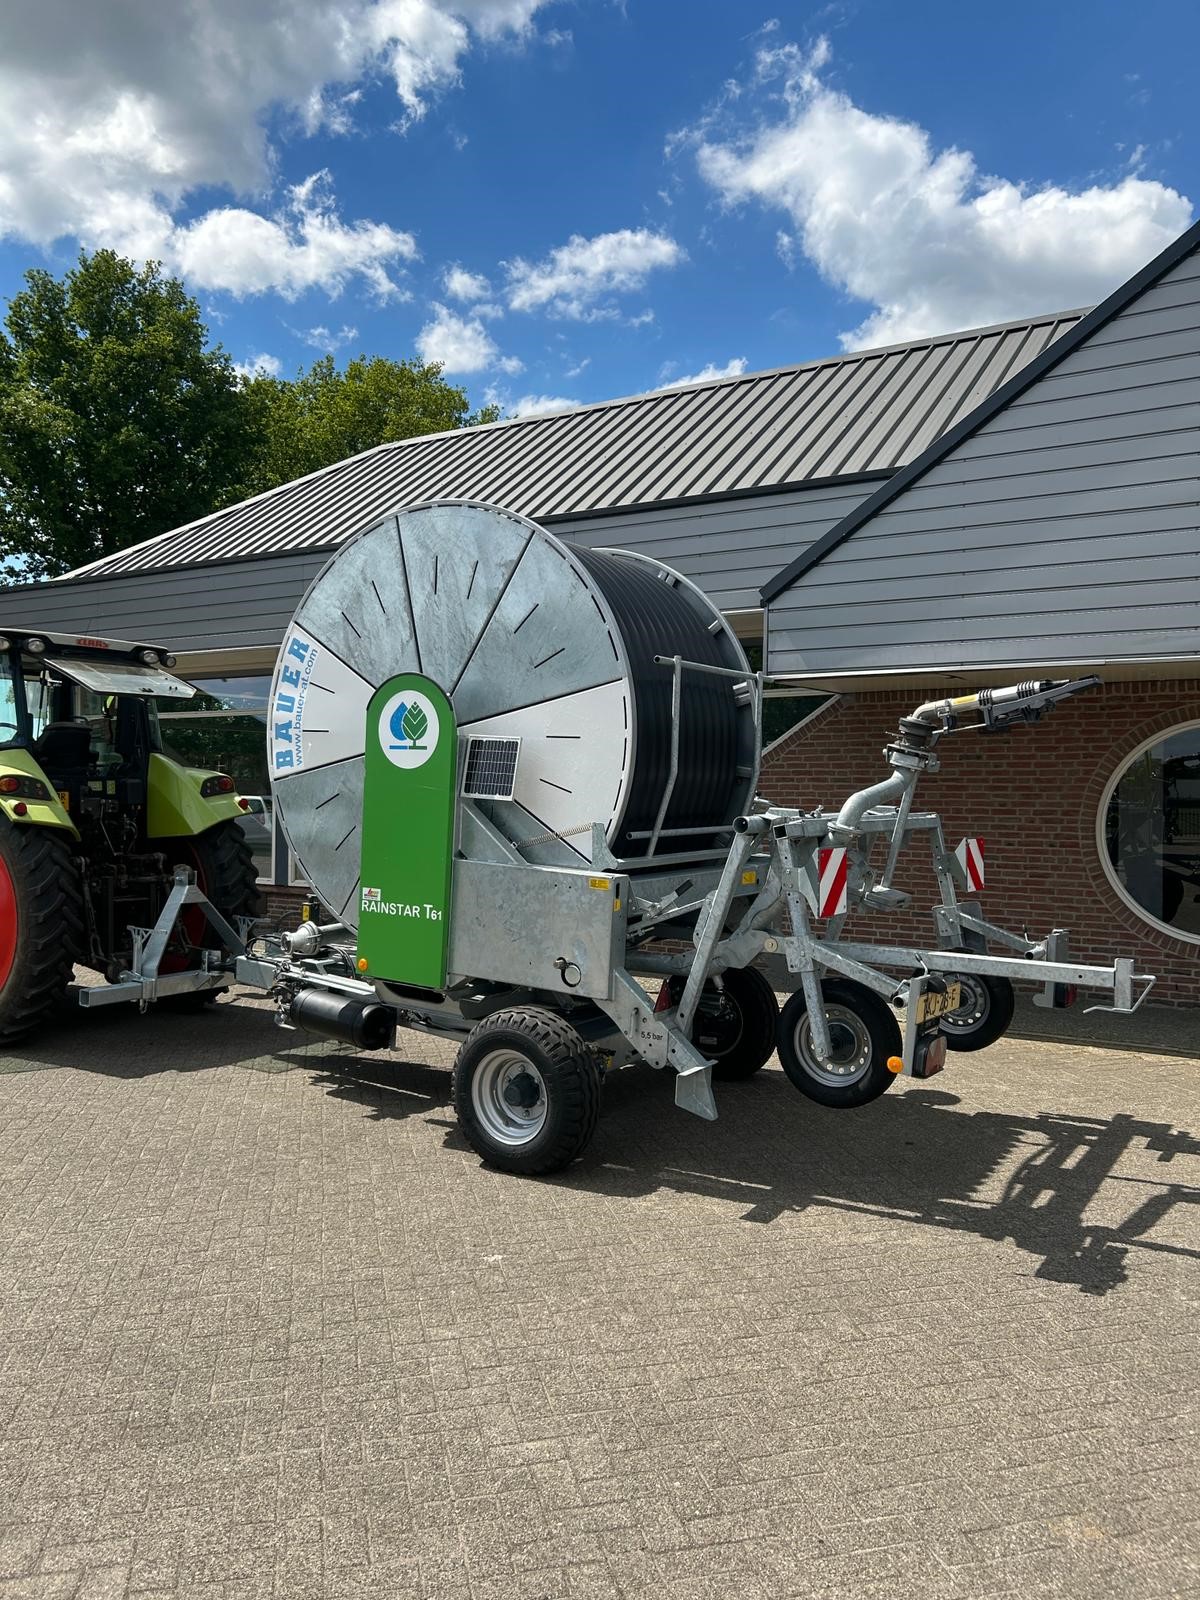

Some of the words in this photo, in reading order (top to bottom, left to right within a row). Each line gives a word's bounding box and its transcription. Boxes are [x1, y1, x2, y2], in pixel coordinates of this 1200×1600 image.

[275, 637, 310, 770] BAUER
[293, 648, 318, 767] www.bauer-at.com
[362, 900, 420, 918] RAINSTAR
[423, 904, 442, 920] T61
[652, 1033, 663, 1041] bar
